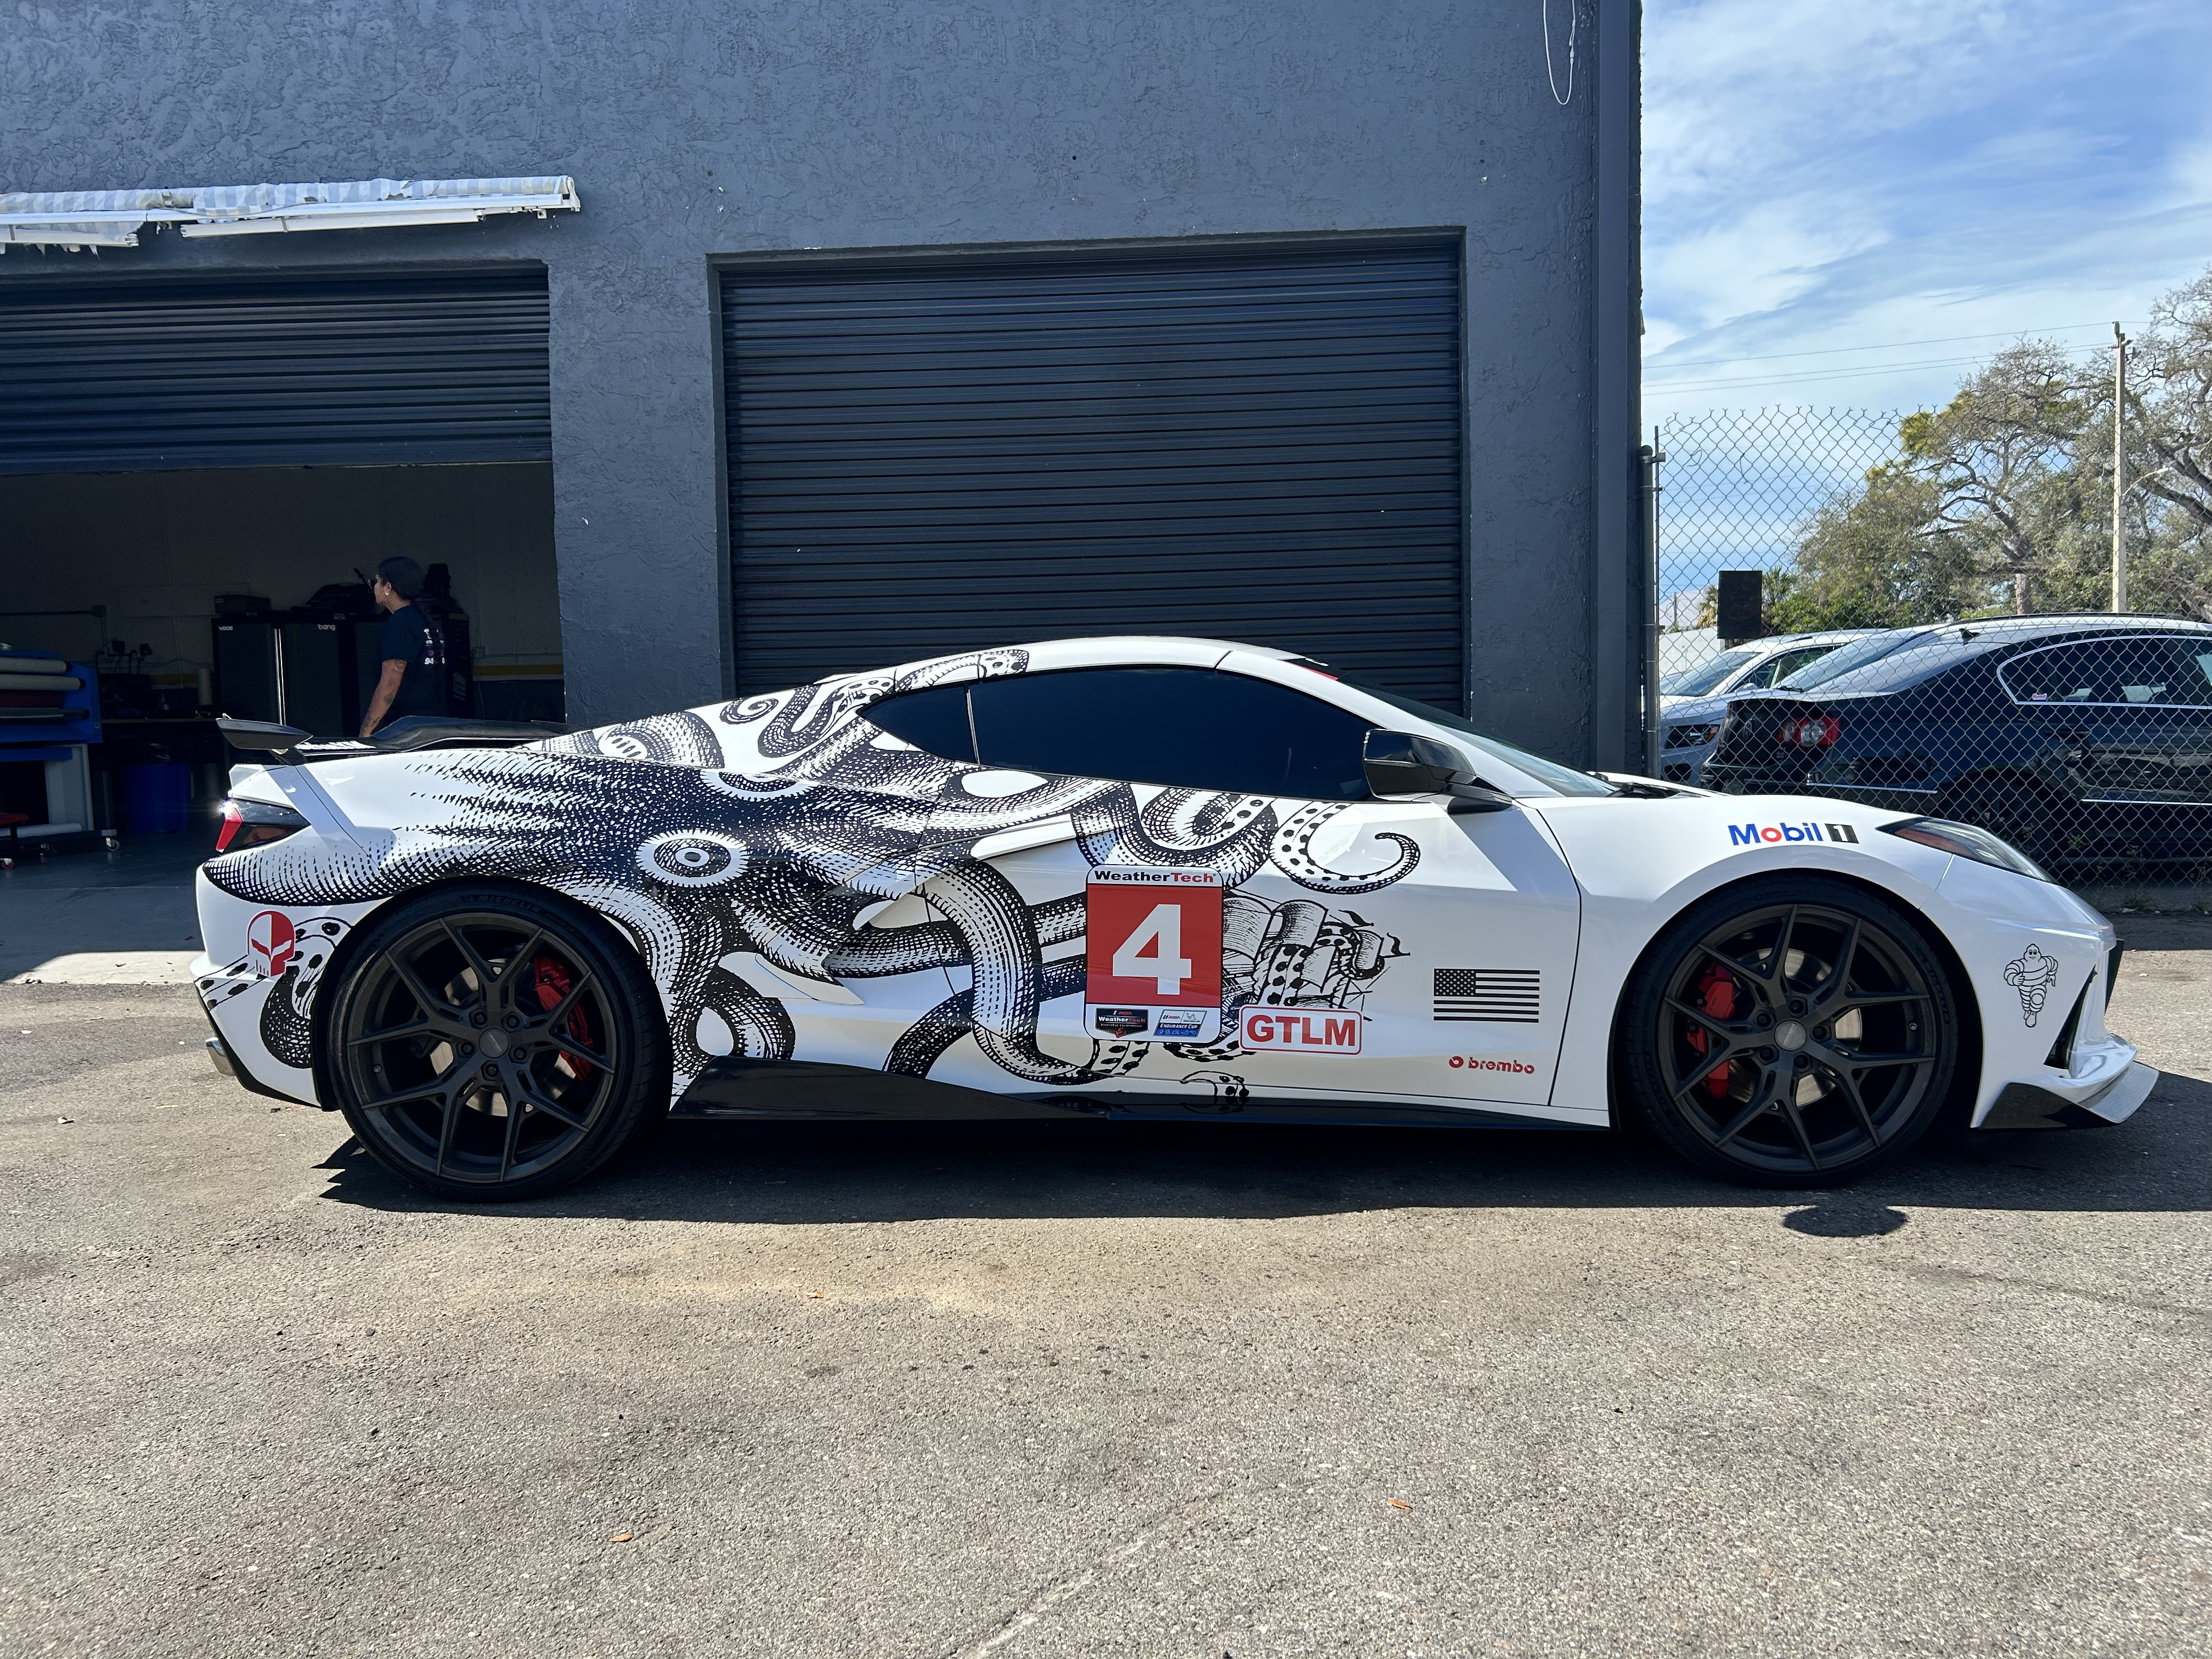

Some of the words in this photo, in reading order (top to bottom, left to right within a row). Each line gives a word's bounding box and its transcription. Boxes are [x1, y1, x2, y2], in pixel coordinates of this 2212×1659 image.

[317, 623, 336, 631] bang
[1728, 822, 1824, 845] Mobil
[1831, 824, 1852, 843] 1
[1094, 871, 1214, 883] WeatherTech
[478, 895, 541, 912] MICHELIN
[1112, 904, 1192, 995] 4
[1247, 1014, 1355, 1047] GTLM
[1468, 1057, 1534, 1074] brembo
